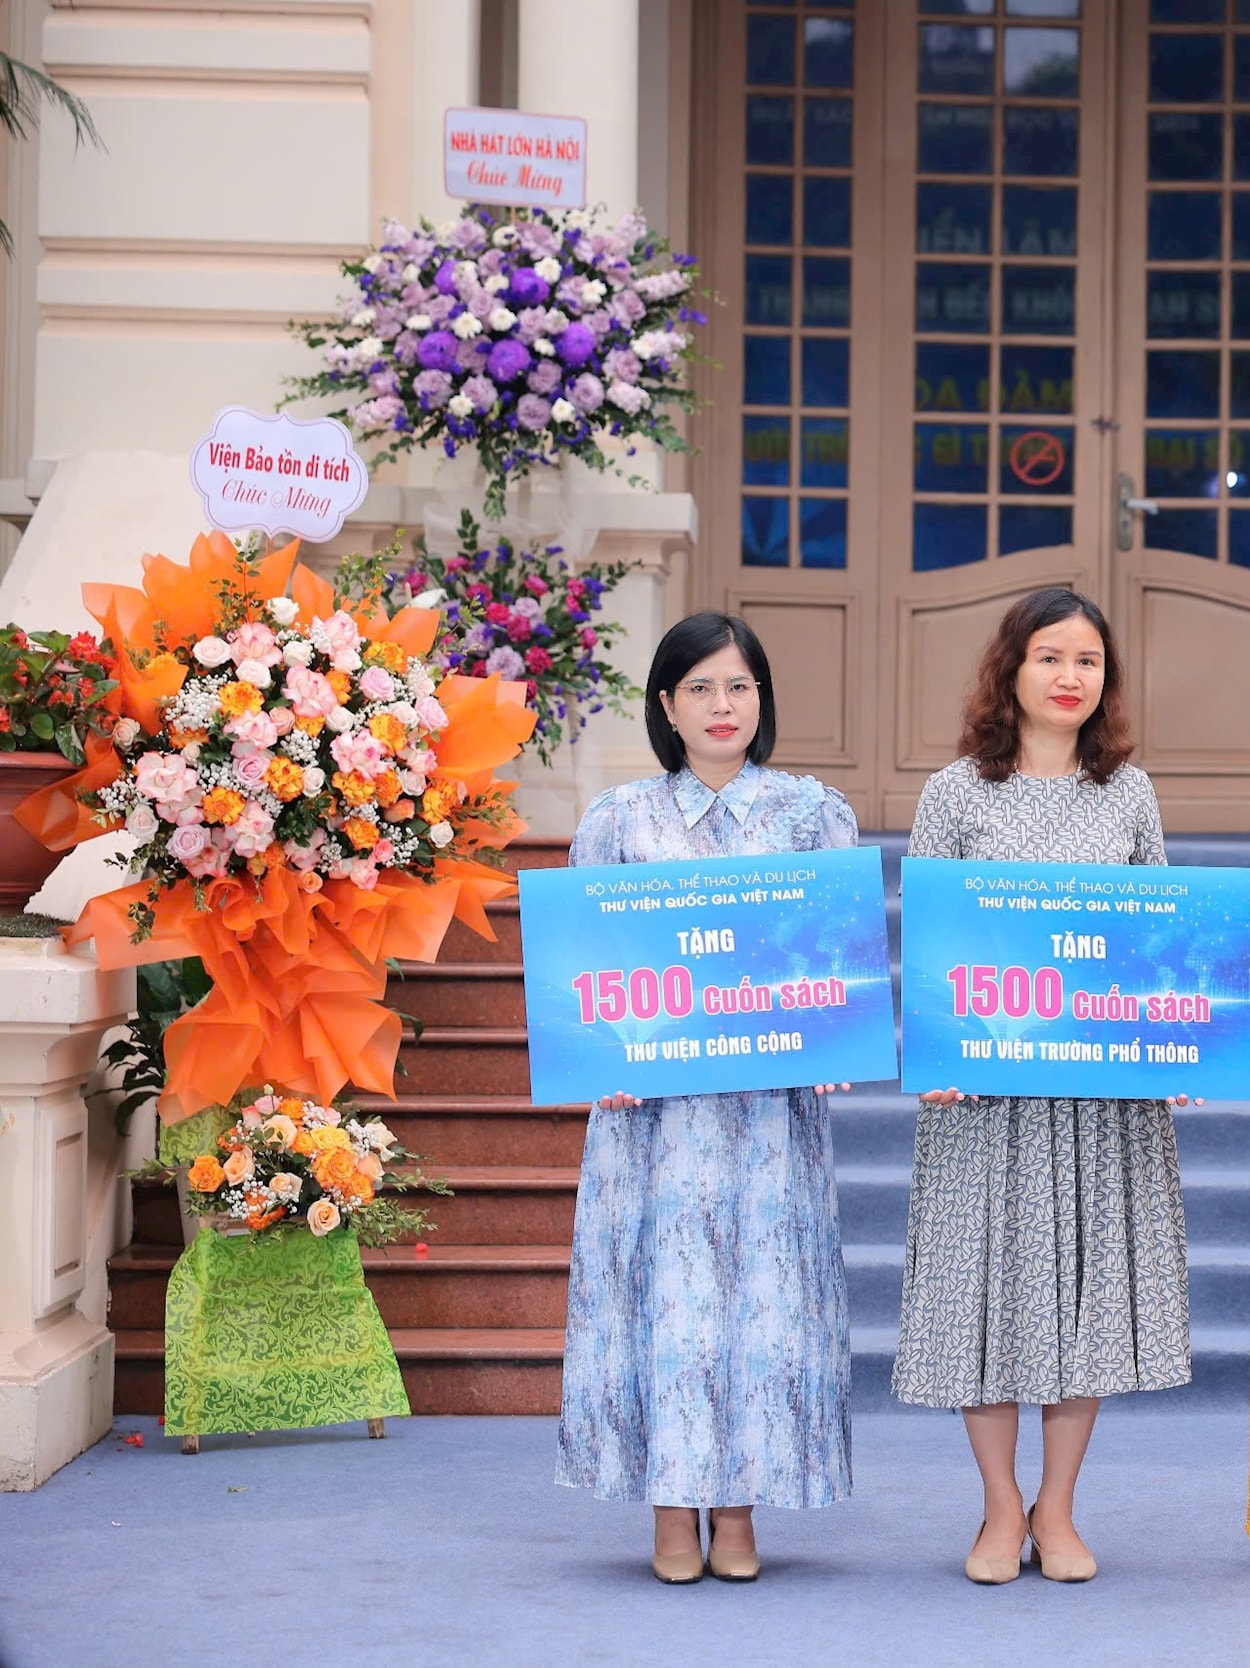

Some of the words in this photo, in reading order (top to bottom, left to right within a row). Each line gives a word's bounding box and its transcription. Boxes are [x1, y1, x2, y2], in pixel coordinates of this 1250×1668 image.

[451, 129, 477, 152] NHÀ
[480, 130, 504, 154] HÁT
[508, 132, 532, 157] LỚN
[536, 135, 552, 159] HÀ
[556, 136, 580, 164] NỘI
[467, 159, 508, 186] Chúc
[209, 442, 241, 474] Viện
[245, 446, 273, 473] Bảo
[278, 448, 300, 476] tồn
[306, 455, 319, 478] di
[324, 457, 350, 482] tích
[222, 479, 267, 505] Chúc
[270, 486, 332, 518] Mừng
[586, 882, 605, 896] BỘ
[608, 881, 637, 894] VĂN
[641, 878, 674, 891] HÓA,
[678, 873, 699, 889] THỂ
[703, 875, 739, 887] THAO
[742, 871, 762, 884] VÀ
[765, 872, 783, 883] DU
[787, 869, 816, 883] LỊCH
[966, 877, 984, 891] BỘ
[987, 878, 1015, 890] VĂN
[1019, 879, 1050, 892] HÓA,
[1055, 877, 1076, 892] THỂ
[1079, 882, 1114, 894] THAO
[1117, 882, 1135, 894] VÀ
[1139, 884, 1156, 895] DU
[1160, 884, 1188, 896] LỊCH
[600, 900, 626, 912] THƯ
[630, 896, 660, 912] VIỆN
[665, 892, 707, 908] QUỐC
[712, 894, 737, 904] GIA
[741, 889, 768, 904] VIỆT
[772, 888, 804, 900] NAM
[978, 897, 1004, 908] THƯ
[1008, 896, 1036, 912] VIỆN
[1041, 896, 1082, 910] QUỐC
[1086, 900, 1110, 911] GIA
[1115, 899, 1141, 914] VIỆT
[1145, 902, 1176, 913] NAM
[677, 927, 734, 959] TẶNG
[1051, 931, 1106, 962] TẶNG
[572, 965, 694, 1024] 1500
[780, 976, 847, 1010] sách
[947, 964, 1064, 1020] 1500
[1146, 990, 1211, 1022] sách
[624, 1041, 657, 1062] THƯ
[662, 1037, 700, 1062] VIỆN
[706, 1034, 751, 1056] CÔNG
[757, 1031, 802, 1055] CỘNG
[961, 1040, 992, 1058] THƯ
[997, 1038, 1034, 1062] VIỆN
[1039, 1040, 1102, 1061] TRƯỜNG
[1109, 1037, 1140, 1062] PHỔ
[1146, 1042, 1198, 1063] THÔNG
